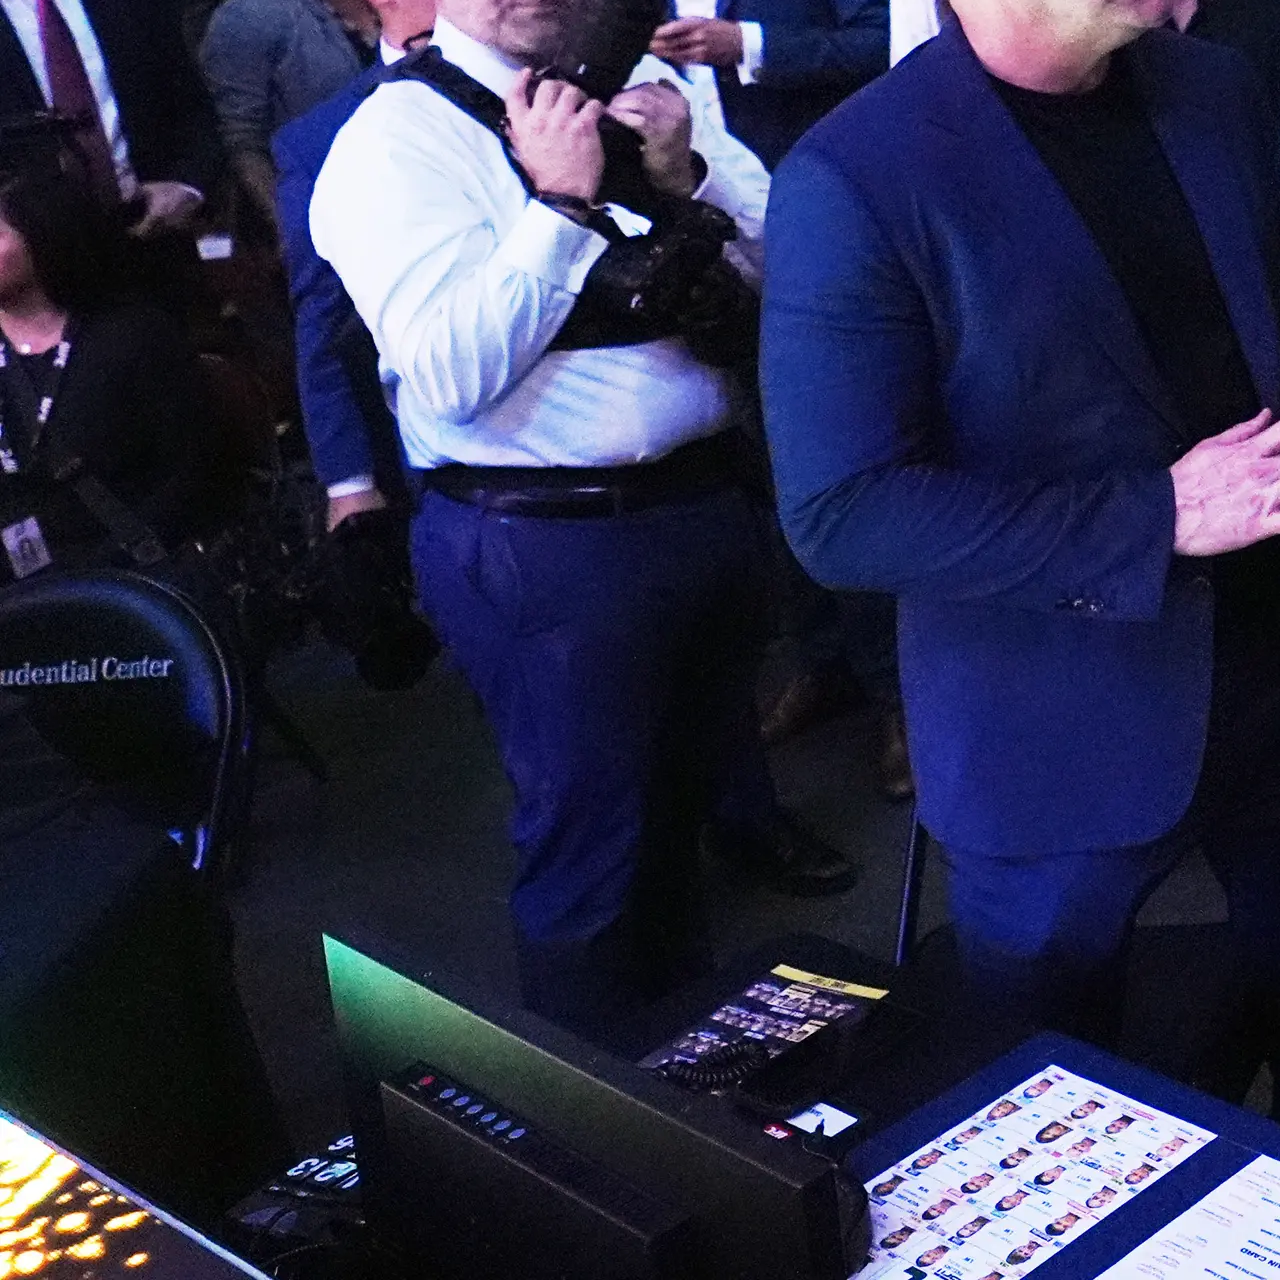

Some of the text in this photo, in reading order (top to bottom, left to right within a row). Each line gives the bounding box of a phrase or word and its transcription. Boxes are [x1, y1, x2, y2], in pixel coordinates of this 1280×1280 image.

[0, 654, 174, 687] udential Center
[1239, 1246, 1268, 1263] CARD
